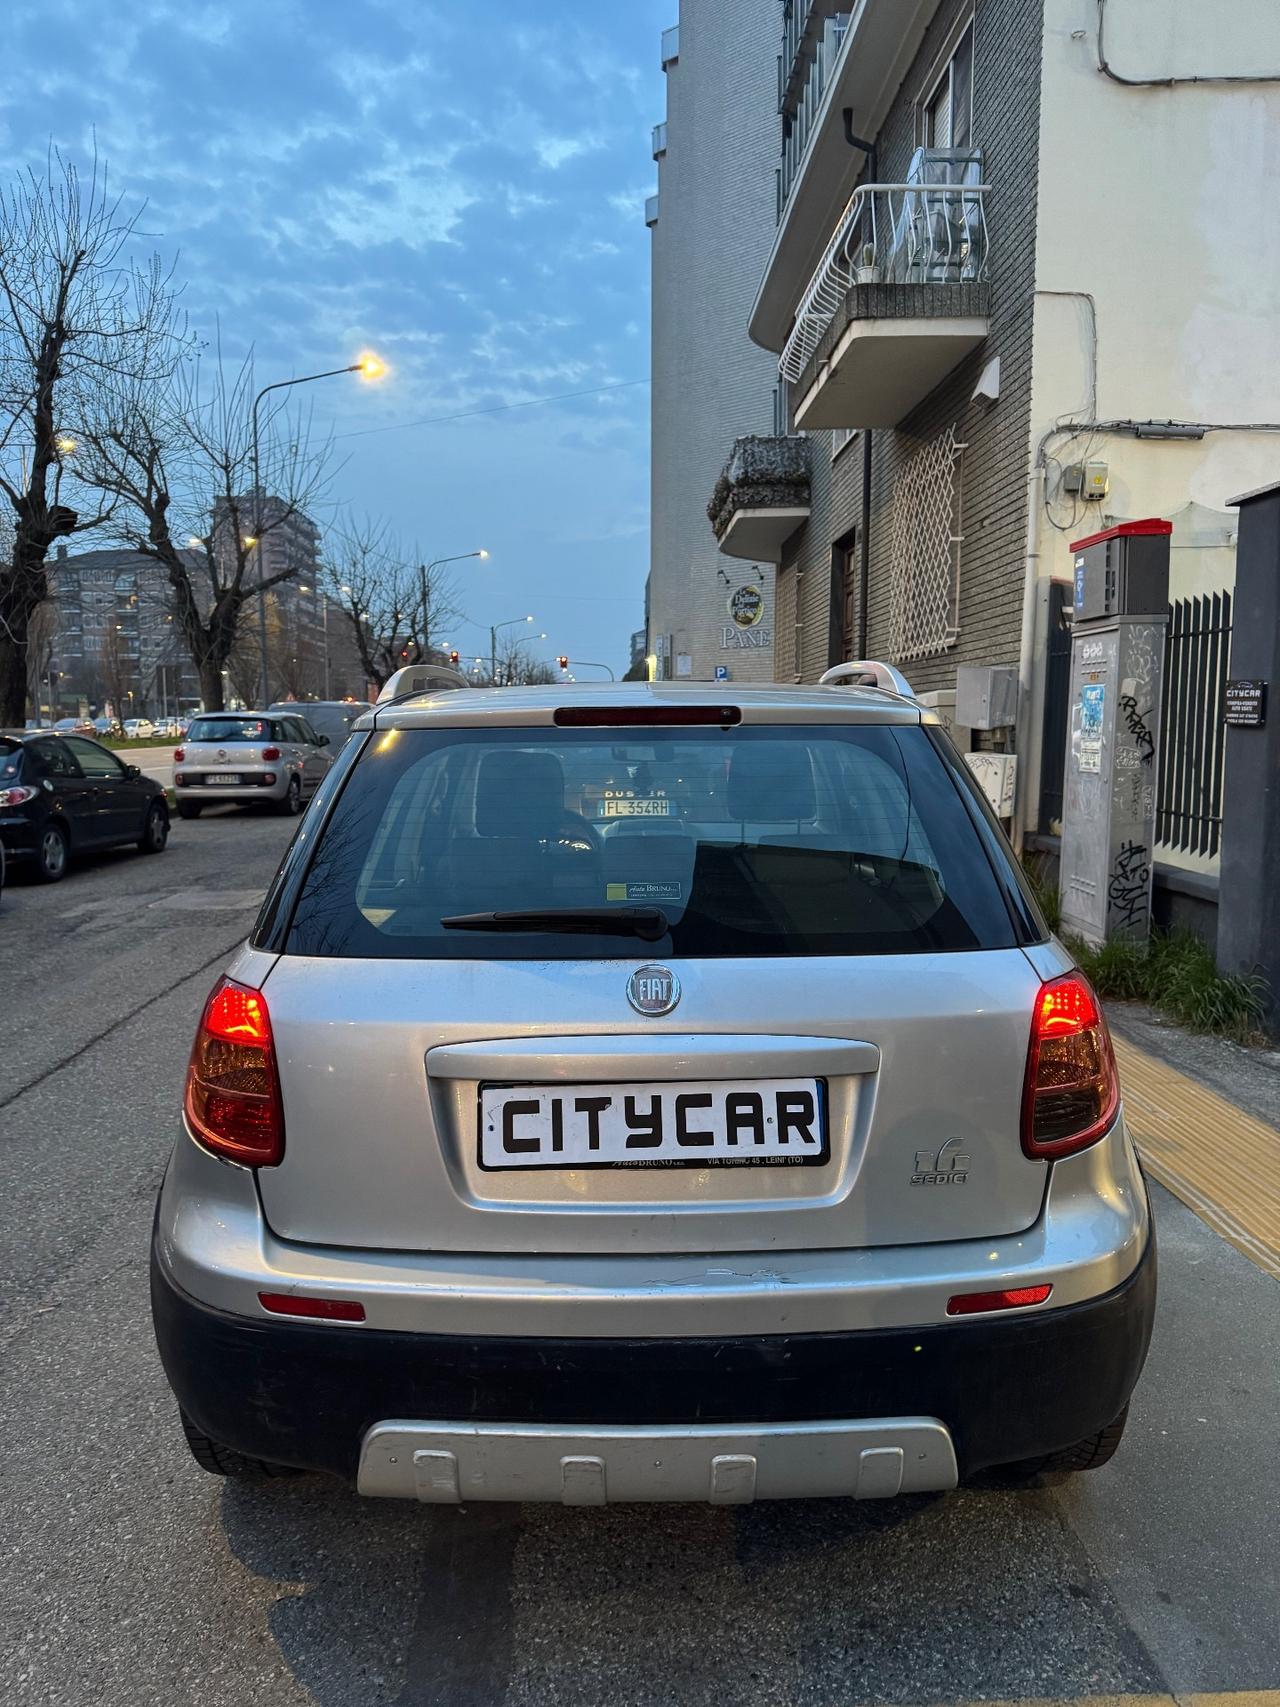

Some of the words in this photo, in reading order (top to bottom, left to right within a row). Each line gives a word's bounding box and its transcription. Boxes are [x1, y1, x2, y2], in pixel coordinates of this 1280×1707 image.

[720, 627, 770, 649] PANE
[716, 667, 726, 678] P
[1226, 689, 1261, 698] CITYCAR
[605, 790, 666, 798] DUSER
[607, 801, 623, 814] FL
[628, 801, 668, 814] 354RH
[639, 978, 671, 1001] FIAT
[502, 1090, 817, 1154] CITYCAR
[787, 1155, 804, 1165] (TO)
[910, 1172, 969, 1186] SEDICI
